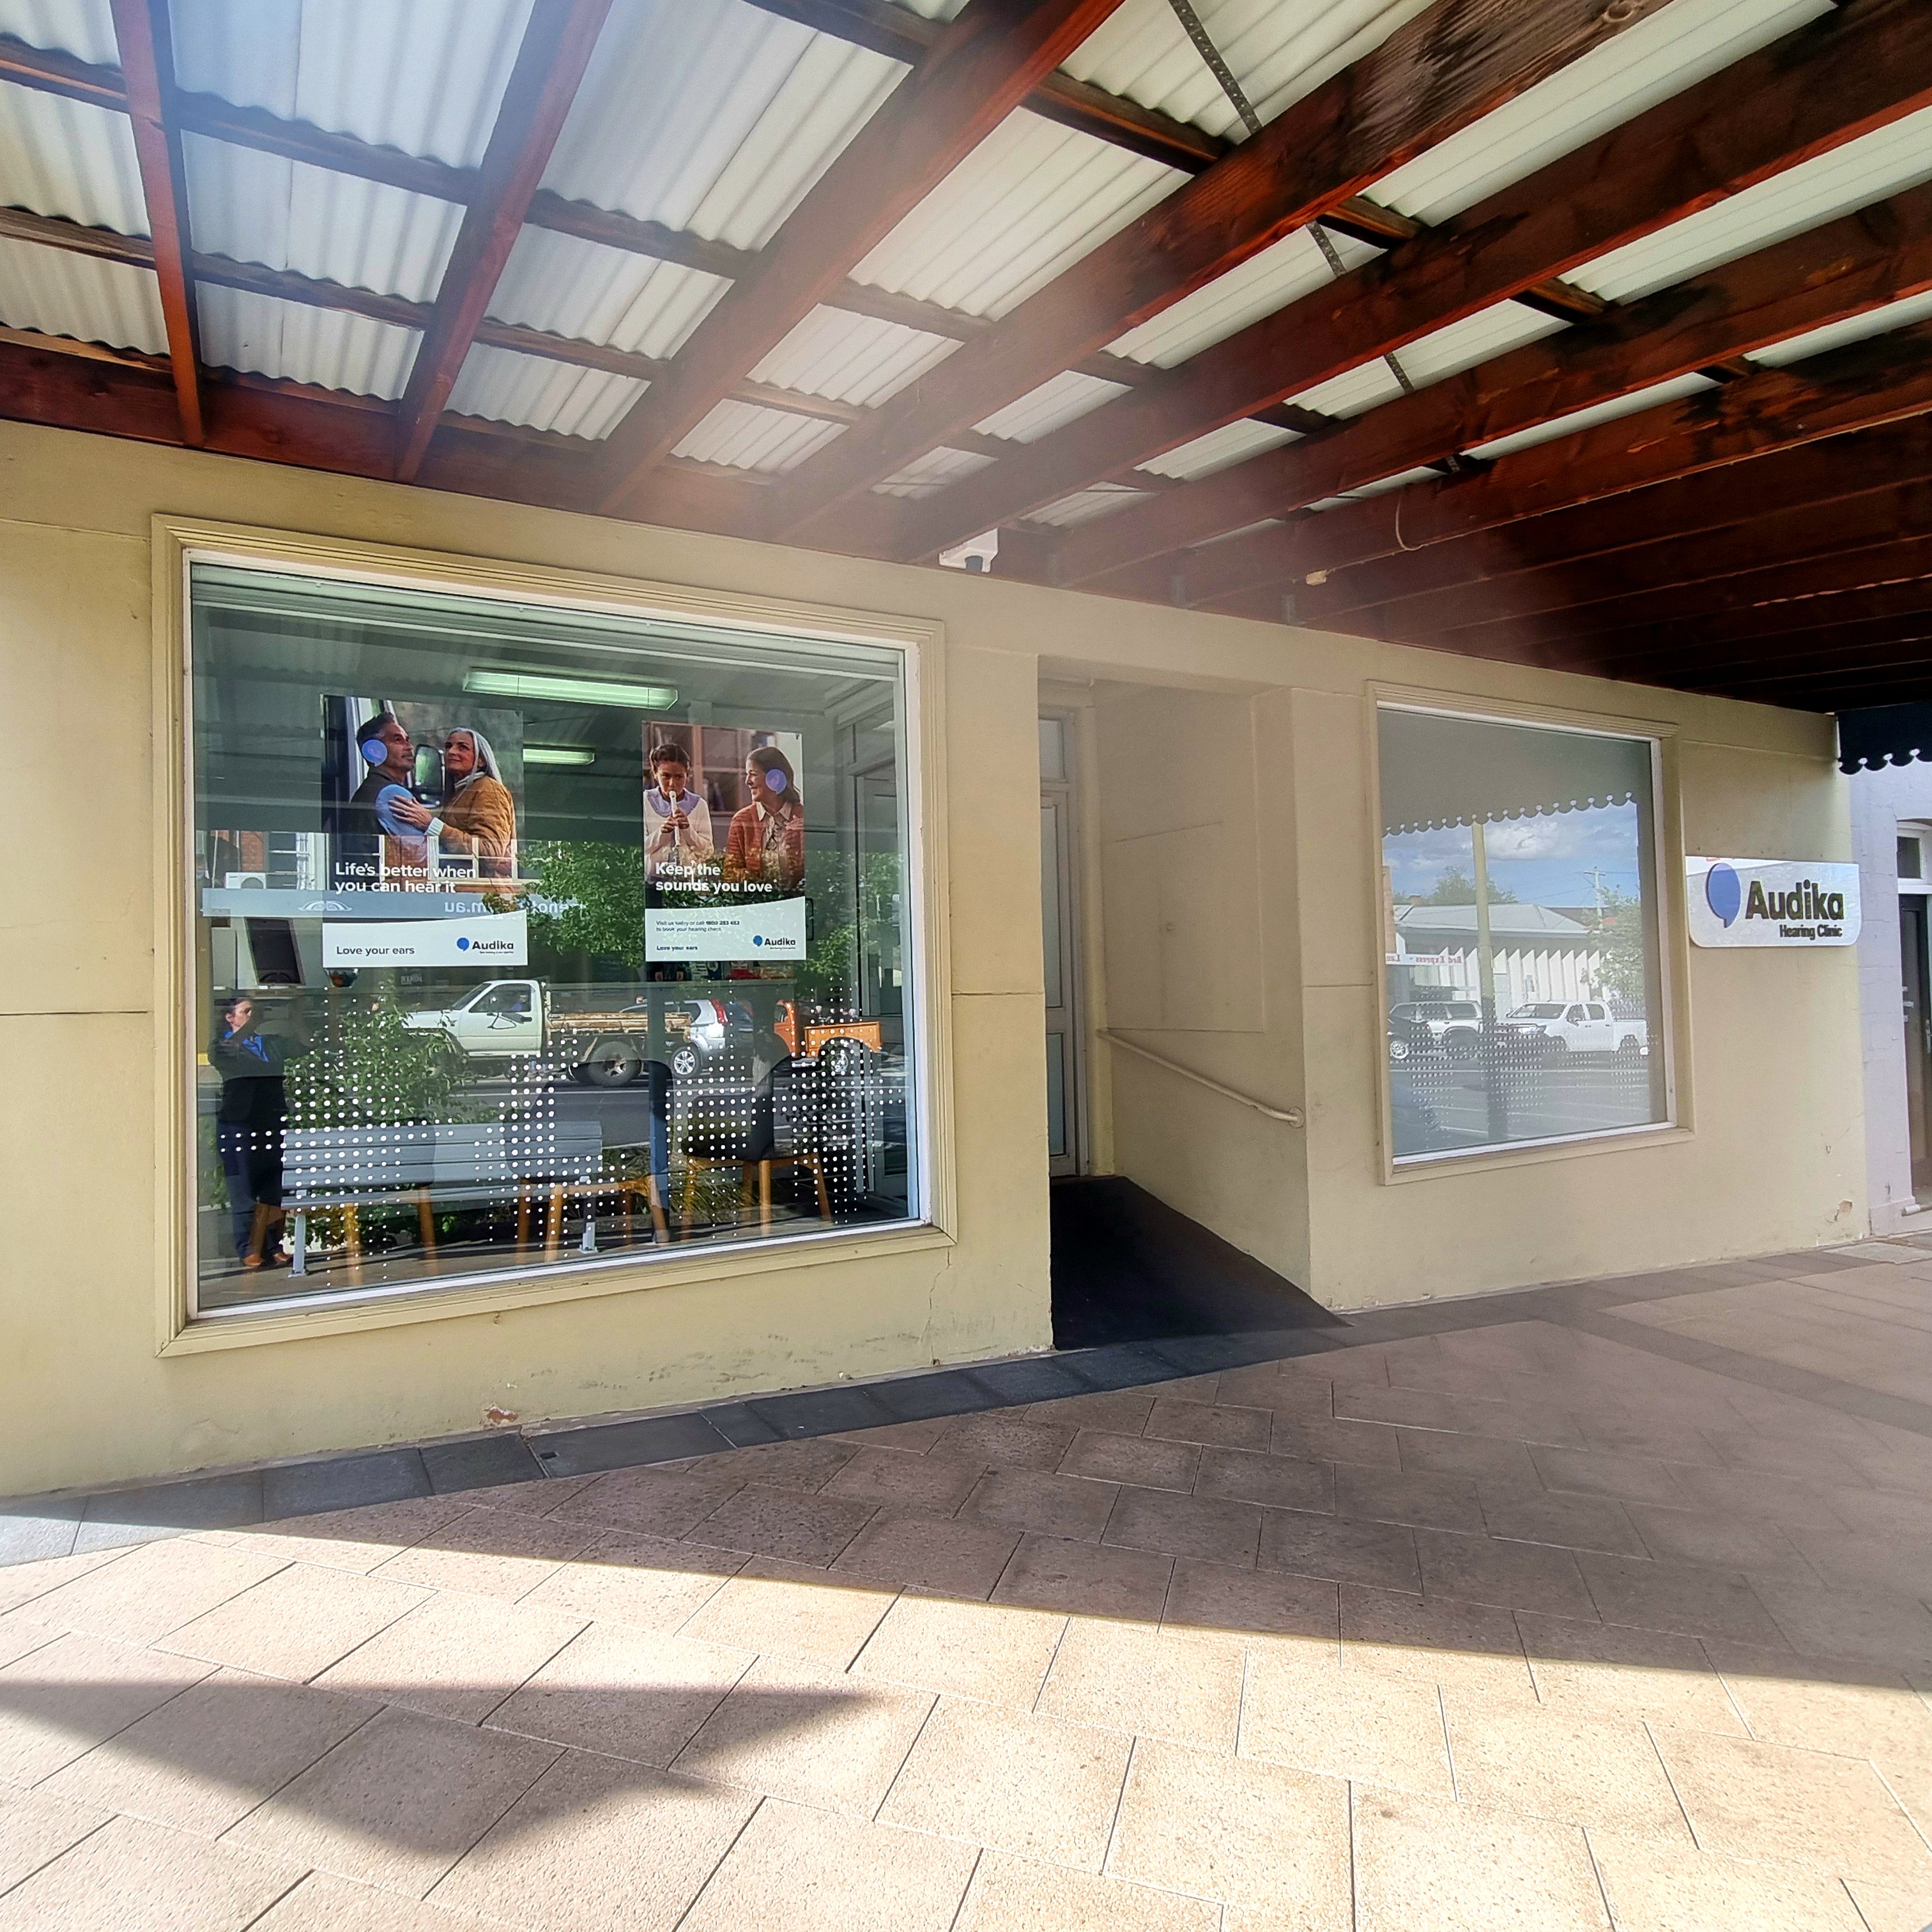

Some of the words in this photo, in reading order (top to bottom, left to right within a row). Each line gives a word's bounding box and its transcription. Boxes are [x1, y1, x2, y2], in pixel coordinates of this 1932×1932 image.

[335, 862, 375, 875] Life's
[381, 864, 429, 877] better
[433, 864, 476, 878] when
[656, 862, 693, 877] Keep
[696, 863, 721, 876] the
[335, 881, 366, 894] you
[371, 882, 401, 893] can
[405, 880, 441, 893] hear
[445, 880, 456, 893] it
[656, 879, 710, 891] sounds
[712, 882, 740, 894] you
[744, 880, 772, 893] love
[1745, 879, 1844, 921] Audika
[1779, 924, 1816, 940] Hearing
[1817, 924, 1843, 937] Clinic
[471, 940, 514, 950] Audika
[764, 937, 796, 946] Audika
[336, 946, 363, 954] Love
[365, 947, 390, 957] your
